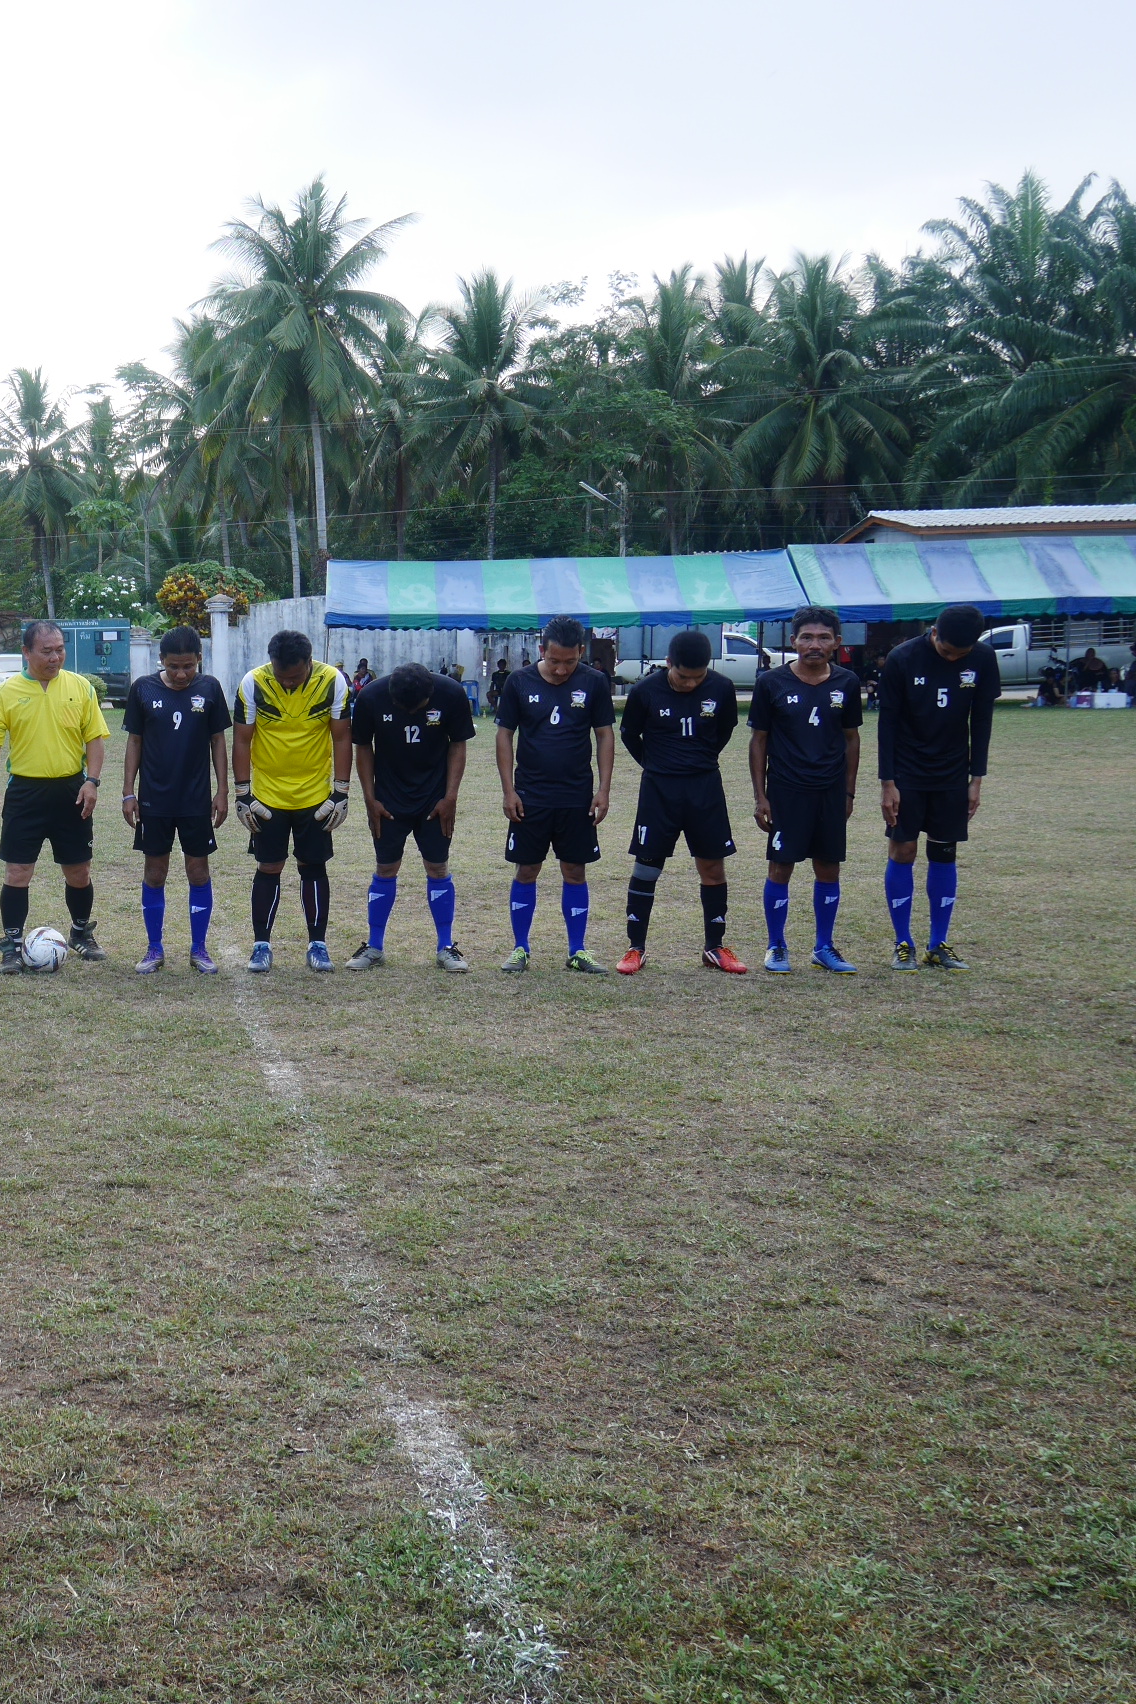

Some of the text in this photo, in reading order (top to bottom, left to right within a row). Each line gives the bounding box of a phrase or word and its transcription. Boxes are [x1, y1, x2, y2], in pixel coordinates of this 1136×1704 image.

[936, 688, 948, 708] 5
[172, 711, 183, 730] 9
[550, 705, 560, 725] 6
[808, 706, 820, 727] 4
[404, 725, 421, 744] 12
[679, 716, 693, 737] 11
[508, 832, 515, 851] 6
[771, 831, 782, 851] 4
